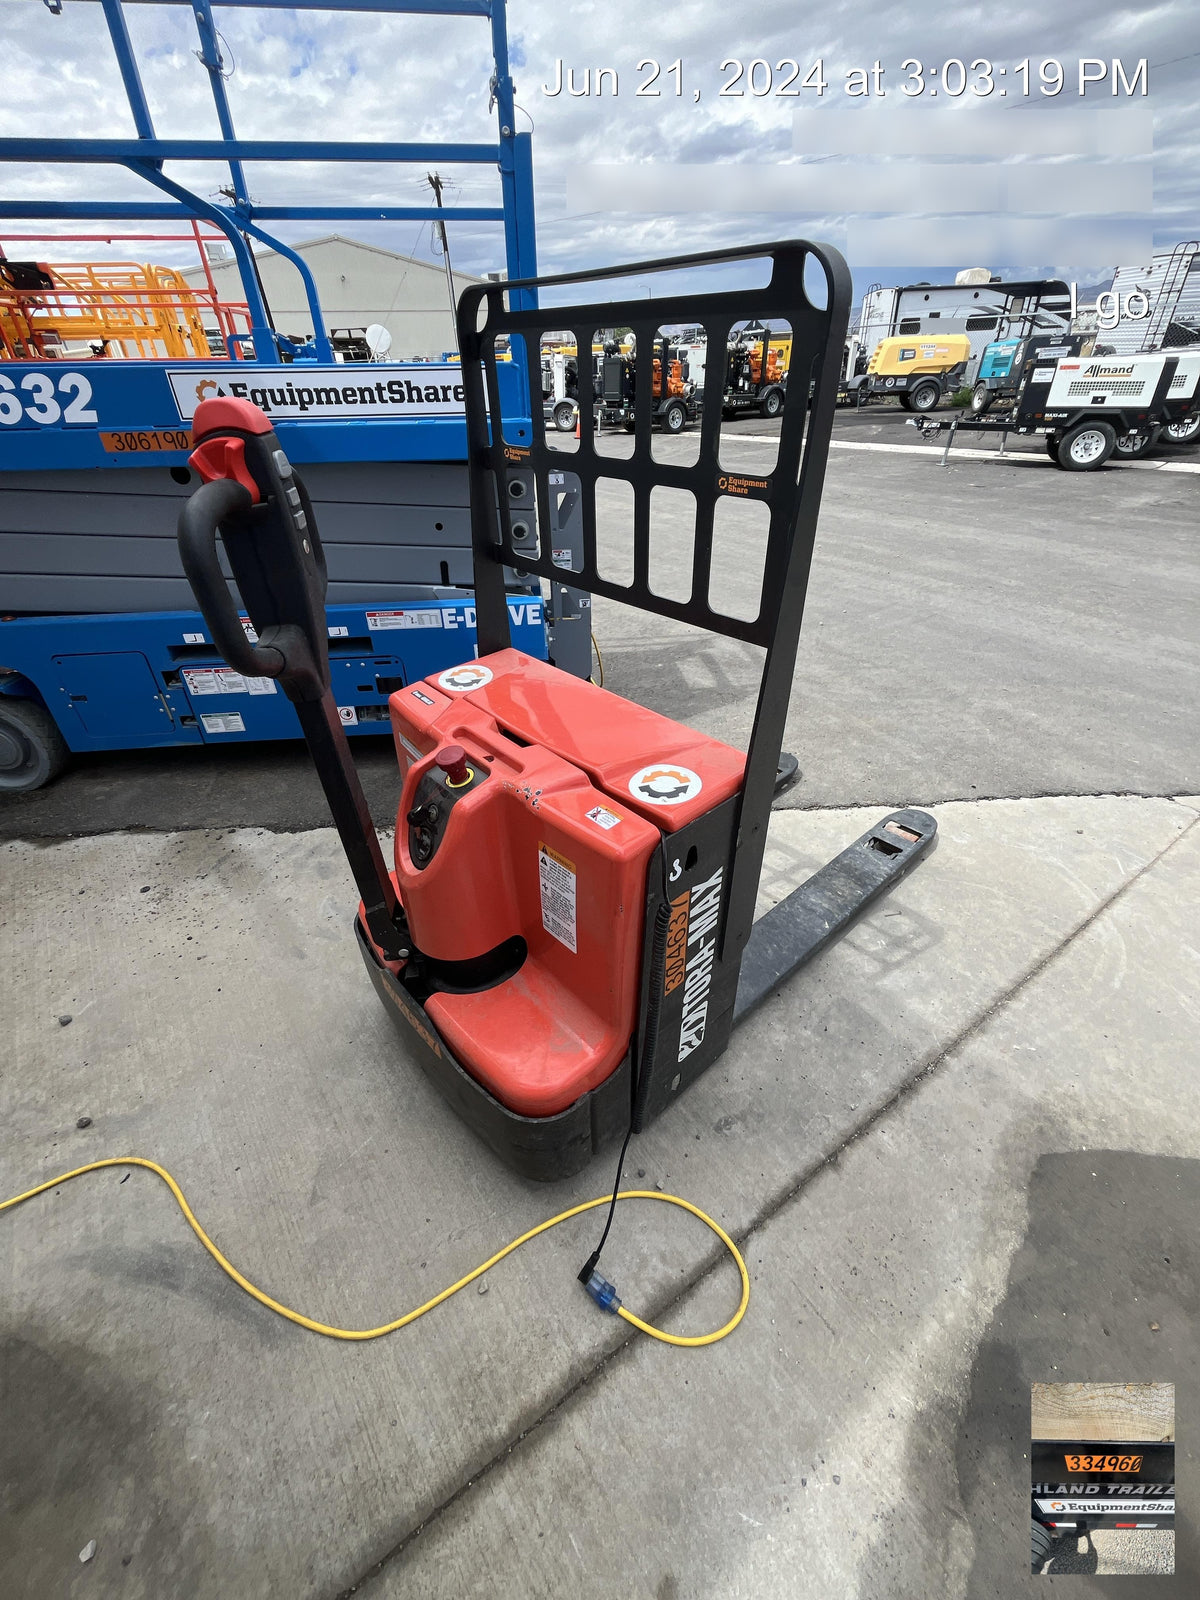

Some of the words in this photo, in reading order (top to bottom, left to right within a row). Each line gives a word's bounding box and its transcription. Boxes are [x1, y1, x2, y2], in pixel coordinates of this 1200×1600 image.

[1084, 364, 1135, 377] Allmand
[0, 372, 99, 425] 632
[229, 380, 465, 411] EquipmentShare
[111, 431, 189, 450] 306190
[727, 484, 749, 494] Share
[728, 476, 768, 488] Equipment
[441, 604, 542, 629] E-DVE
[682, 866, 723, 1019] TORA-MAX
[1070, 1456, 1142, 1471] 334960
